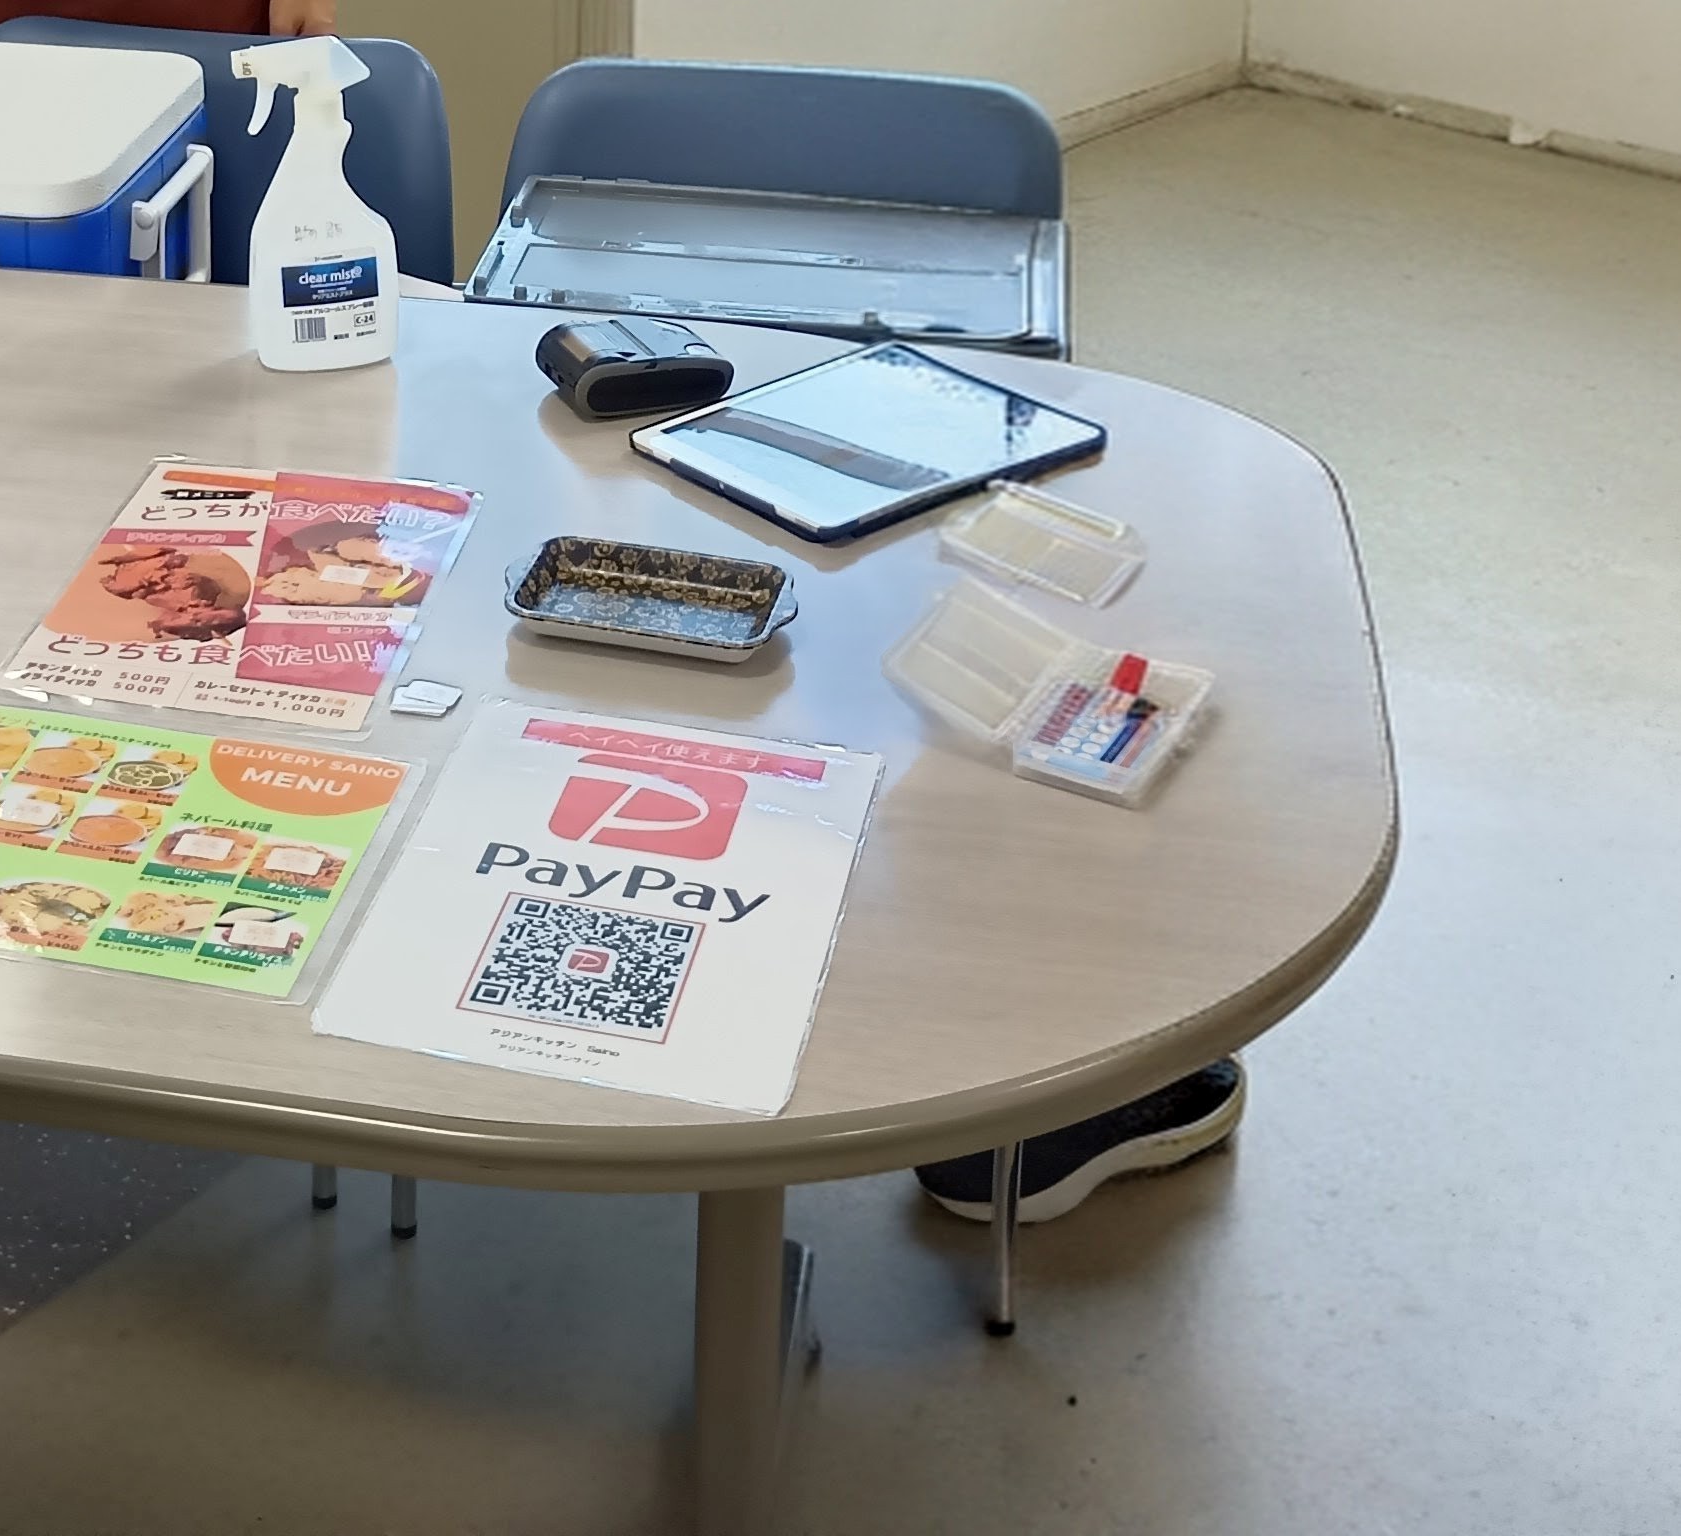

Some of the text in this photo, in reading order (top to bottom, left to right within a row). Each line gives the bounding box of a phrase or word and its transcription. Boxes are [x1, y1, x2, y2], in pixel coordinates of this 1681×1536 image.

[298, 270, 326, 285] clear
[355, 314, 374, 324] C-24
[119, 670, 171, 685] 500円
[113, 681, 165, 696] 500円
[271, 700, 346, 719] 1,000円
[217, 743, 400, 779] DELIVERY SAINO
[240, 766, 353, 797] MENU
[179, 811, 273, 833] ネパール料理
[475, 841, 771, 923] PayPay
[490, 1027, 578, 1049] アリアンキッチン
